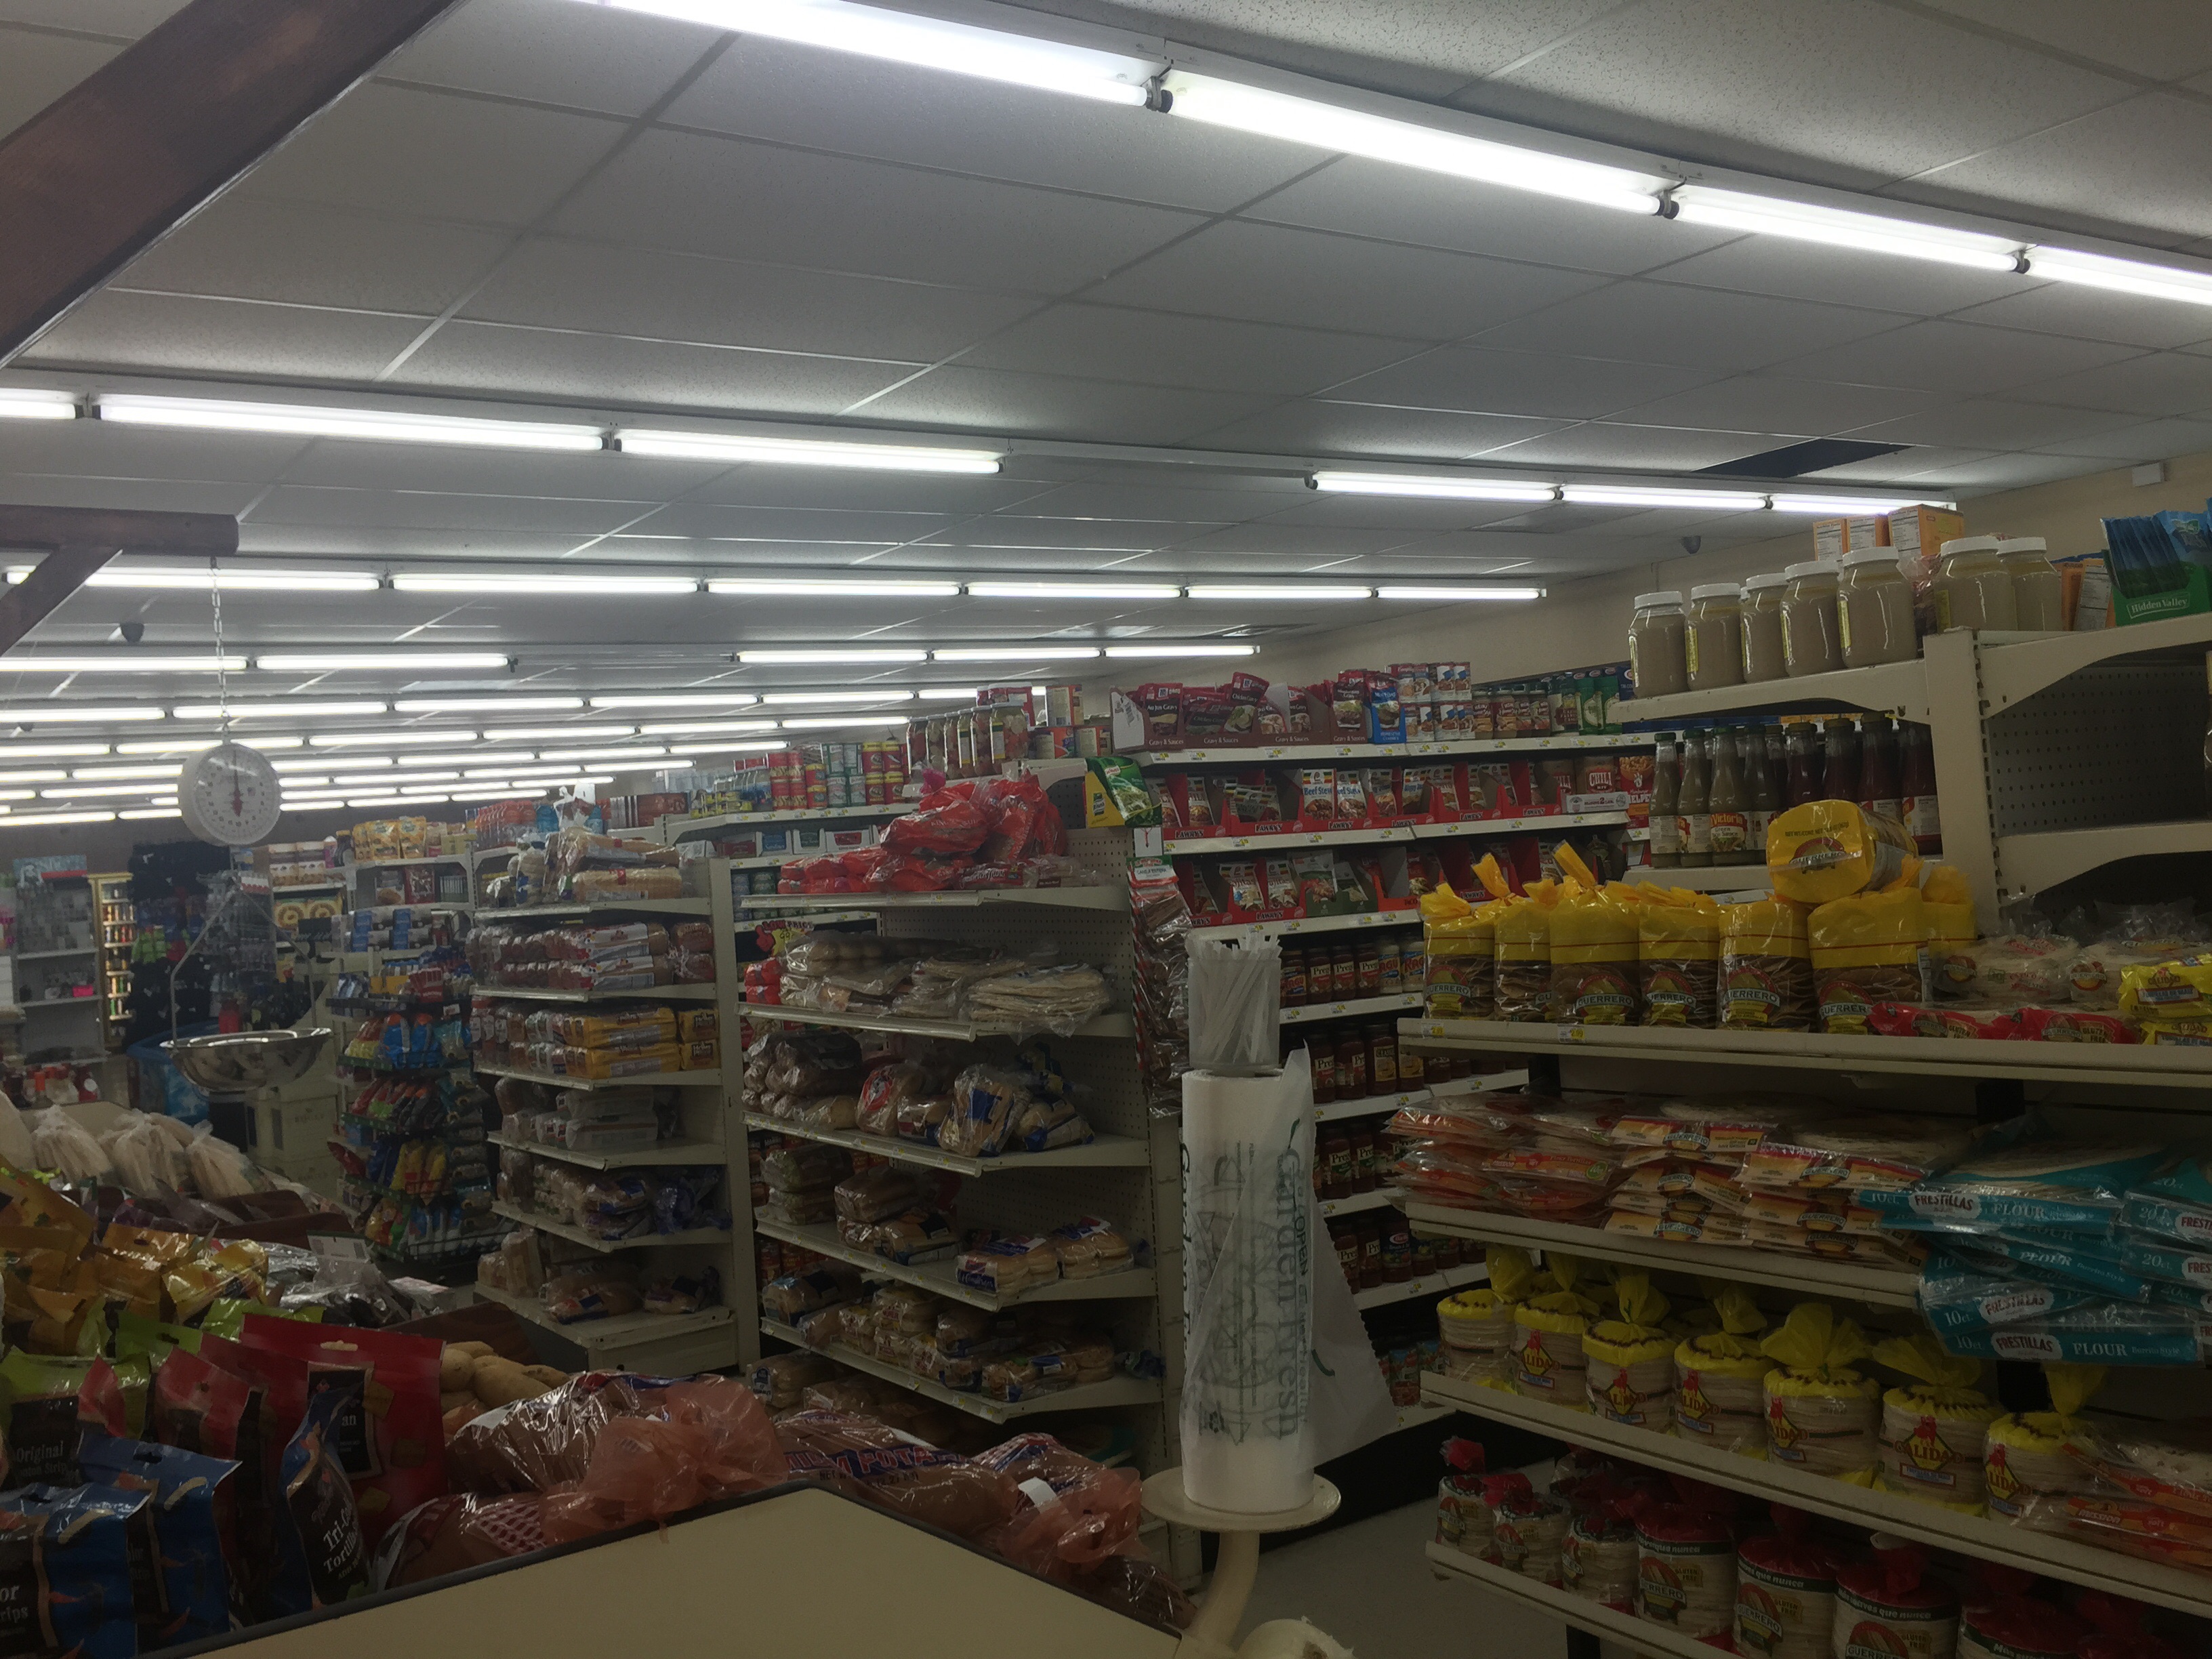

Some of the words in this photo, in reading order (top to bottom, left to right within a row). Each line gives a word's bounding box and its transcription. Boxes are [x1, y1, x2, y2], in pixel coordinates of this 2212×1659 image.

[2131, 599, 2161, 614] Hidden
[2162, 597, 2188, 608] Valley
[1589, 771, 1612, 786] CHILI
[1304, 786, 1319, 796] Beef
[1629, 794, 1650, 803] ELPE
[1711, 813, 1742, 825] Victoria
[1254, 824, 1283, 833] LAWRY'S
[1328, 821, 1353, 830] LAWRY'S
[1174, 830, 1204, 840] LAWRY'S
[1191, 917, 1211, 926] WRY'S
[1256, 912, 1284, 920] LAWRY'S
[762, 920, 786, 931] LOW
[1336, 964, 1353, 972] Preg
[1362, 962, 1378, 970] Preg
[1404, 956, 1424, 970] RAG
[1313, 966, 1330, 975] Preg
[1578, 995, 1633, 1006] GUERRERO
[1651, 991, 1694, 1004] ERRERO
[1914, 1194, 1973, 1211] FRESTILLAS
[1992, 1204, 2046, 1221] FLOUR
[1802, 1213, 1845, 1224] GUERRERO
[1275, 1147, 1300, 1305] Garden
[1294, 1215, 1309, 1277] OPEN
[1809, 1234, 1856, 1246] GUERRERO
[1985, 1294, 2045, 1315] FRESTILLAS
[1995, 1336, 2054, 1353] FRESTILLAS
[2072, 1343, 2129, 1357] FLOUR
[2131, 1346, 2159, 1355] Burrito
[2160, 1346, 2181, 1357] Style
[1277, 1317, 1297, 1439] Fresh
[16, 1441, 64, 1463] Original
[1894, 1441, 1964, 1464] CALIDAD
[2078, 1509, 2121, 1524] MISSION
[1755, 1570, 1772, 1581] que
[1772, 1576, 1804, 1588] nunca
[1737, 1603, 1780, 1632] GUERRERO
[1879, 1608, 1898, 1619] que
